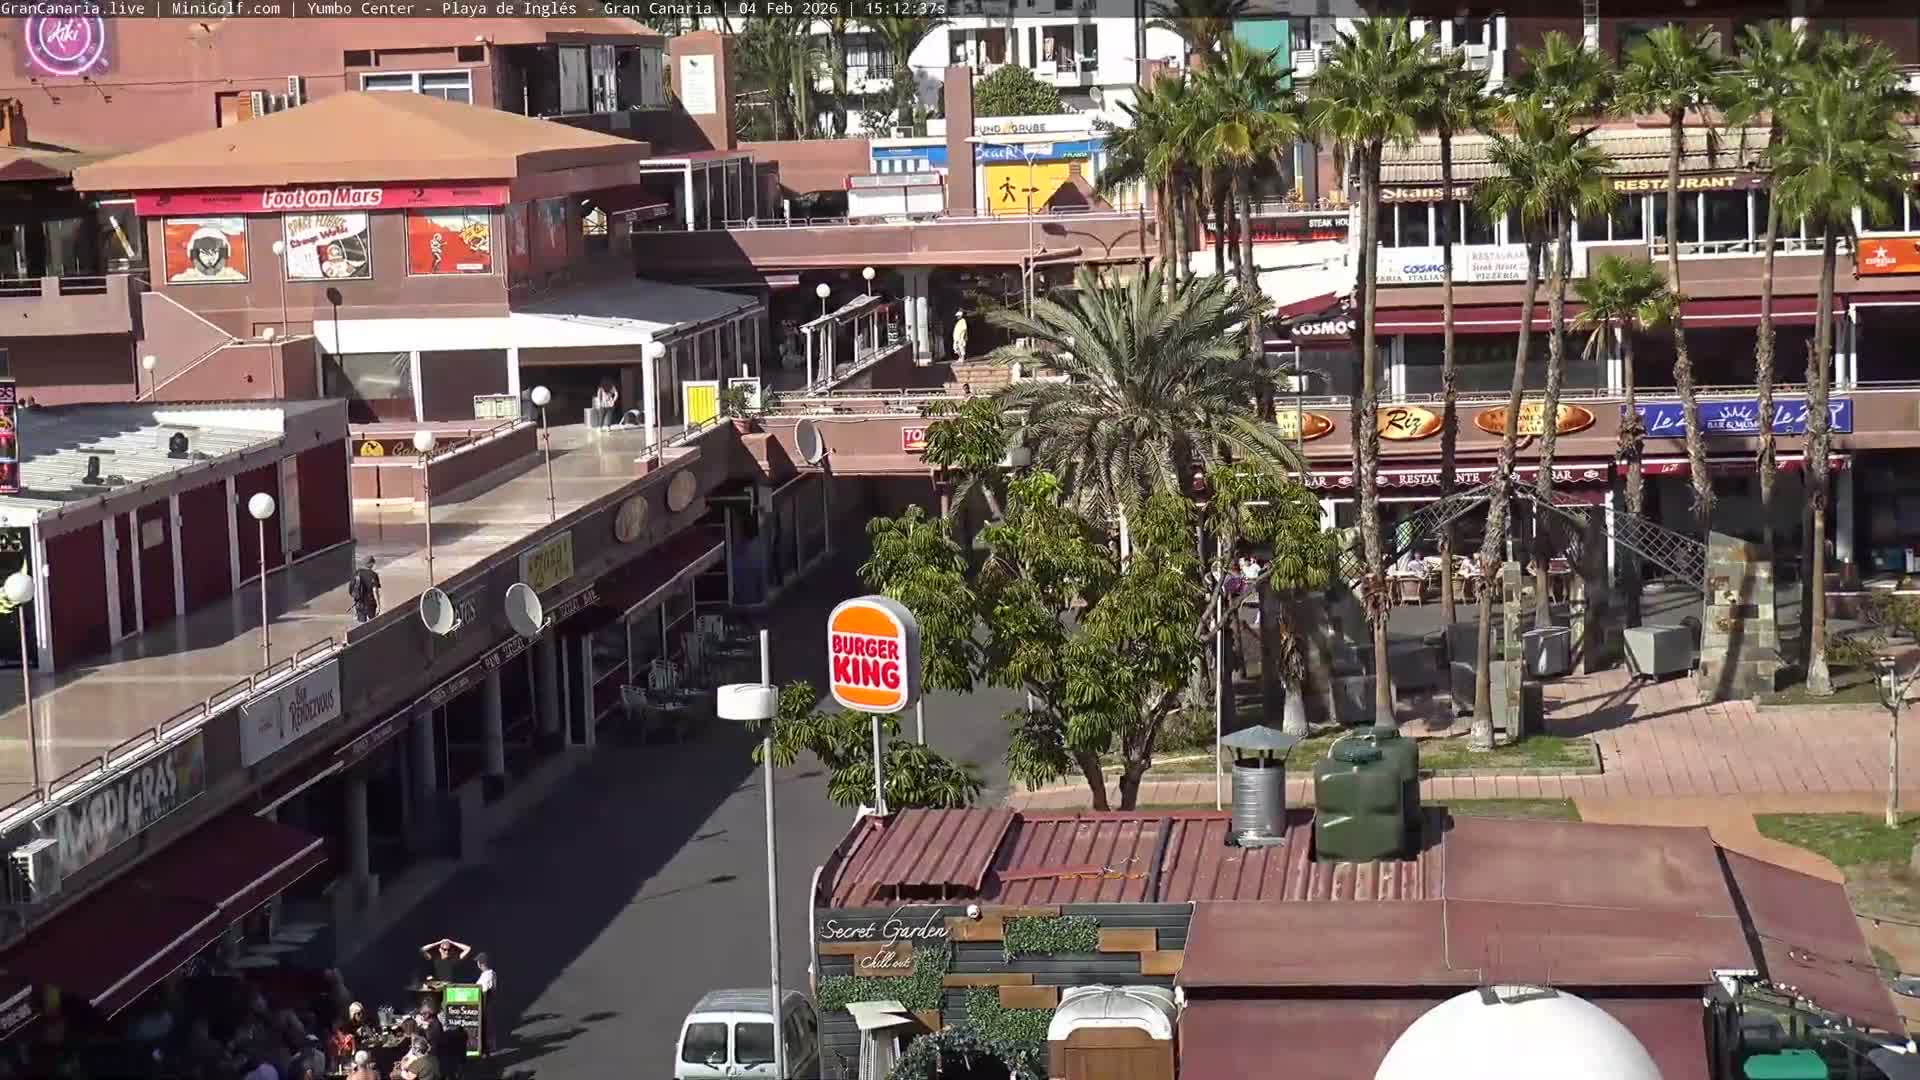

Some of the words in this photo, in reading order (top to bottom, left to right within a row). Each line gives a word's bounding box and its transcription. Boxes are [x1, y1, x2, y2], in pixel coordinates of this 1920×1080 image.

[263, 188, 304, 208] Foot
[306, 190, 332, 207] on
[333, 187, 383, 206] Mars
[1335, 218, 1350, 227] HOU
[1386, 409, 1422, 435] Riz
[1651, 409, 1673, 431] Le
[1772, 405, 1795, 426] Le
[1399, 474, 1480, 484] RESTAUNTE
[832, 635, 899, 660] BURGER
[833, 654, 900, 689] KING
[821, 919, 876, 939] Secret
[880, 905, 949, 948] Garden
[893, 958, 911, 969] out
